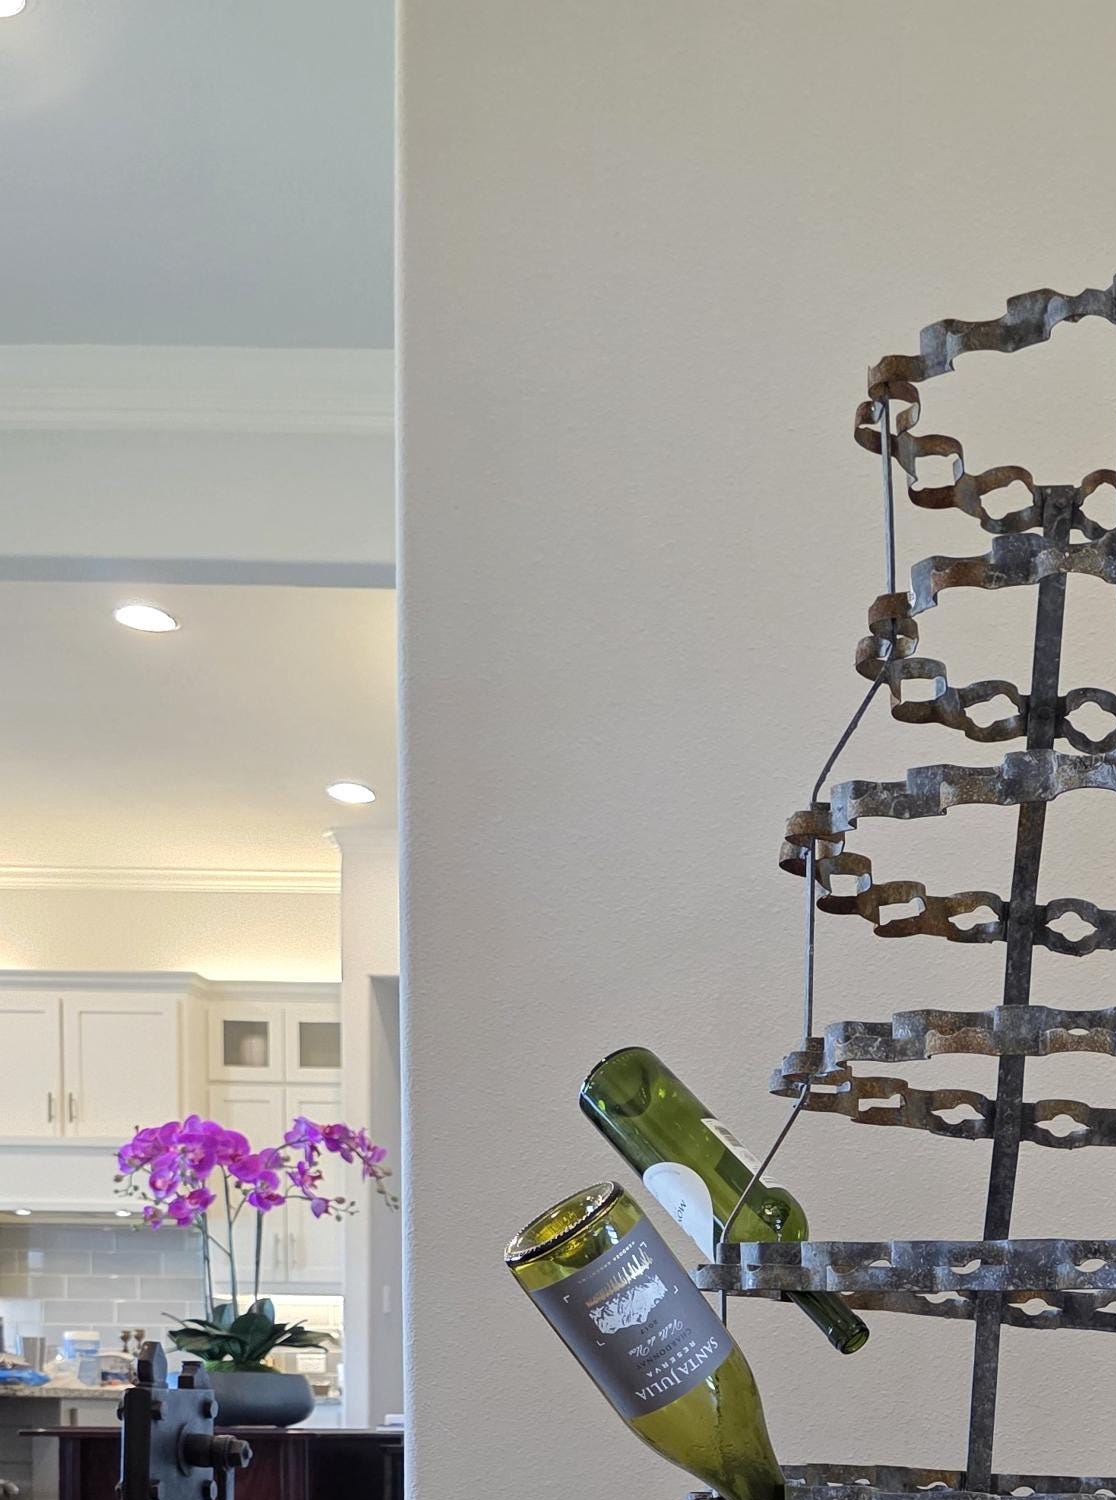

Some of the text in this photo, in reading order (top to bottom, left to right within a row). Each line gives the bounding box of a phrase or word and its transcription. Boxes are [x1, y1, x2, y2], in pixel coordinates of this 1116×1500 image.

[647, 1335, 656, 1347] de
[658, 1318, 684, 1342] Valle
[636, 1328, 692, 1370] CHARDONNAY
[646, 1340, 696, 1377] RESERVA
[635, 1336, 719, 1401] SANTA JULIA
